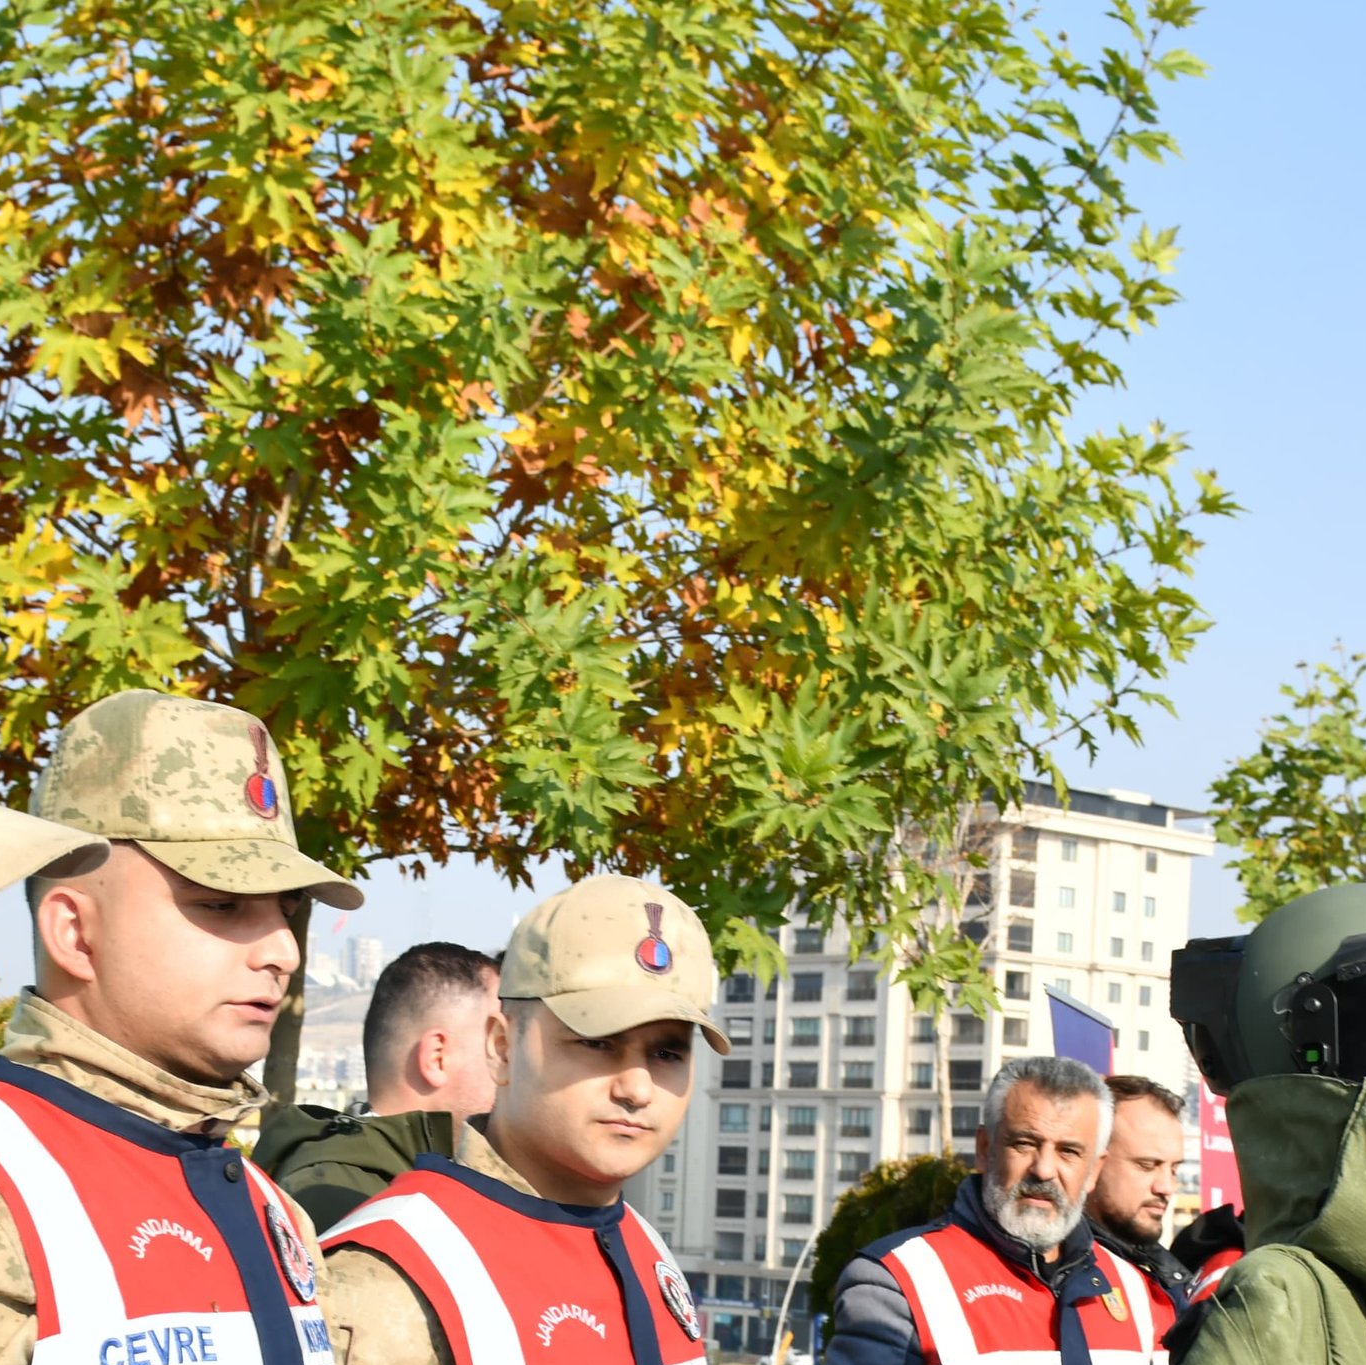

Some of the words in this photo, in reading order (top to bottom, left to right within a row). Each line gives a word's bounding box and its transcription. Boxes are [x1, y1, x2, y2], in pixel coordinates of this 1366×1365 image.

[128, 1218, 213, 1262] JANDARMA
[963, 1283, 1023, 1304] JANDARMA
[536, 1303, 606, 1347] JANDARMA
